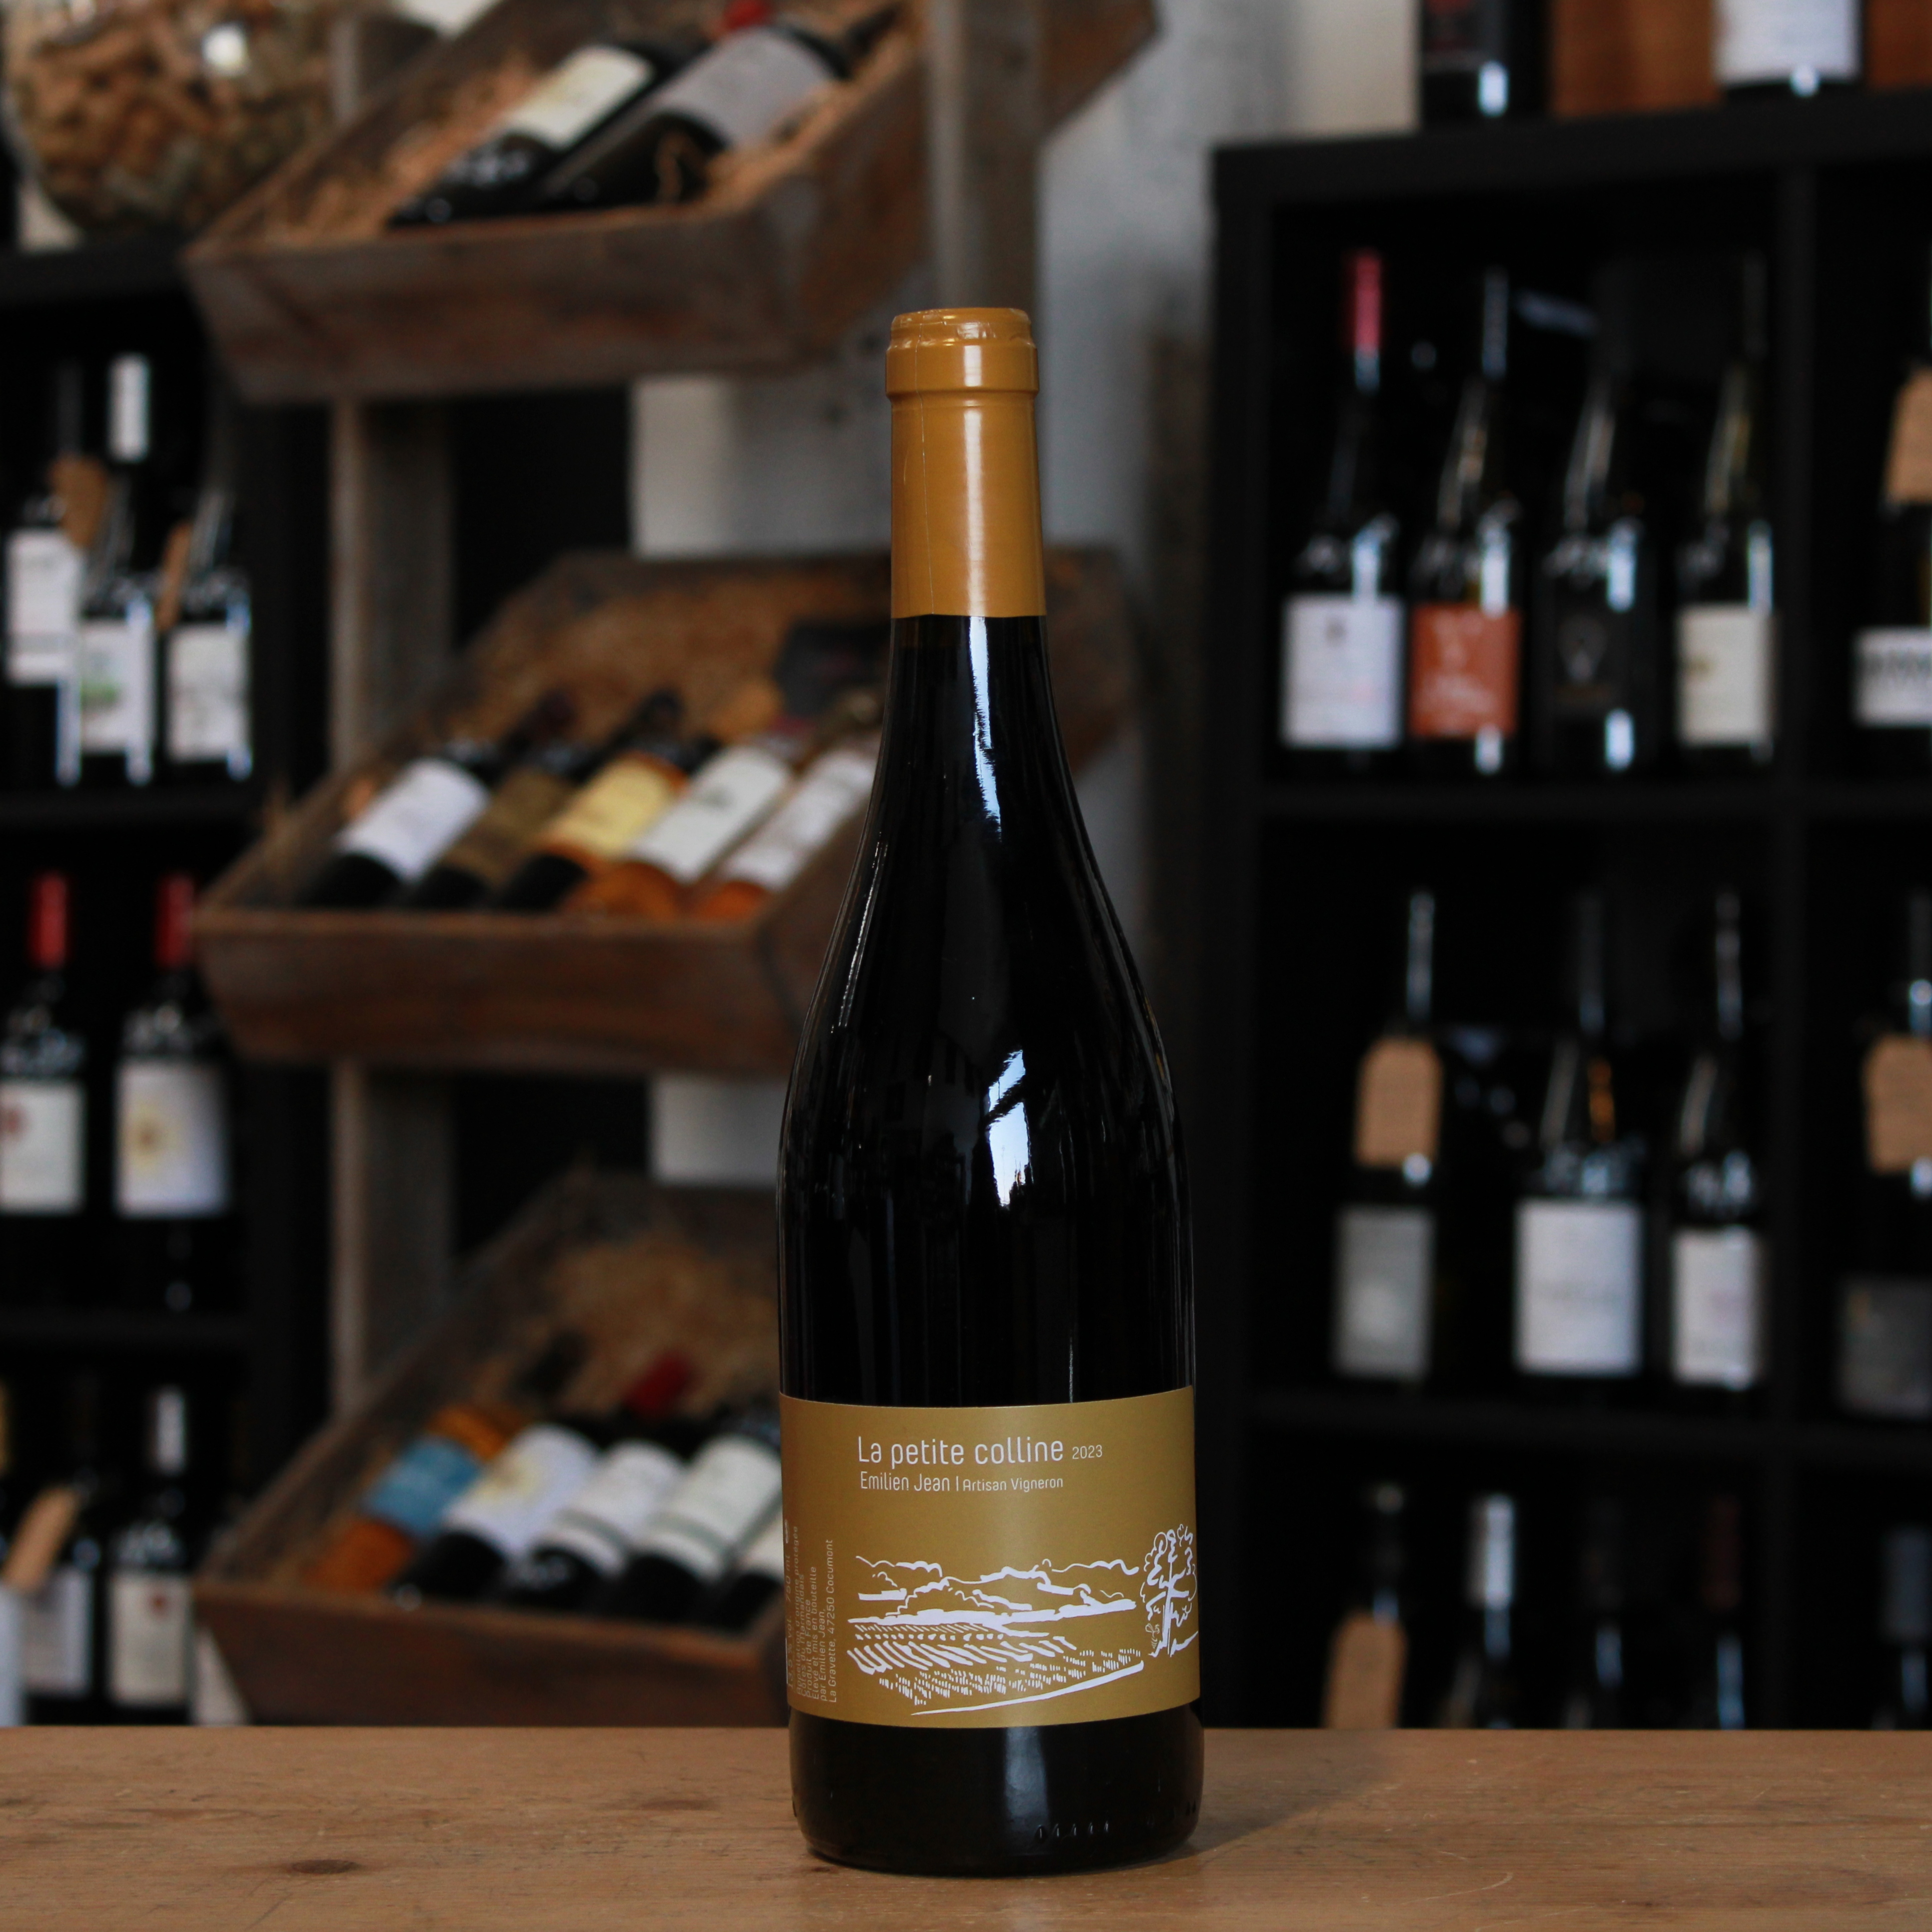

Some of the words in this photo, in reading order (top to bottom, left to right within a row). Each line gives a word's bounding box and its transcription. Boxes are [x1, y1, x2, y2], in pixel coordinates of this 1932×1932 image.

[858, 1436, 882, 1463] La
[891, 1438, 964, 1469] petite
[974, 1436, 1063, 1465] colline
[1072, 1444, 1103, 1460] 2023
[861, 1471, 909, 1491] Emilien
[914, 1473, 950, 1491] Jean
[963, 1479, 1007, 1491] Artisan
[1010, 1477, 1063, 1493] Vigneron
[826, 1539, 834, 1593] Cocumont
[811, 1618, 818, 1630] en
[818, 1608, 826, 1638] Jean,
[826, 1597, 835, 1634] 47250
[800, 1648, 806, 1661] du
[806, 1641, 812, 1654] de
[812, 1656, 818, 1666] et
[828, 1638, 836, 1687] Gravette,
[829, 1690, 836, 1702] La
